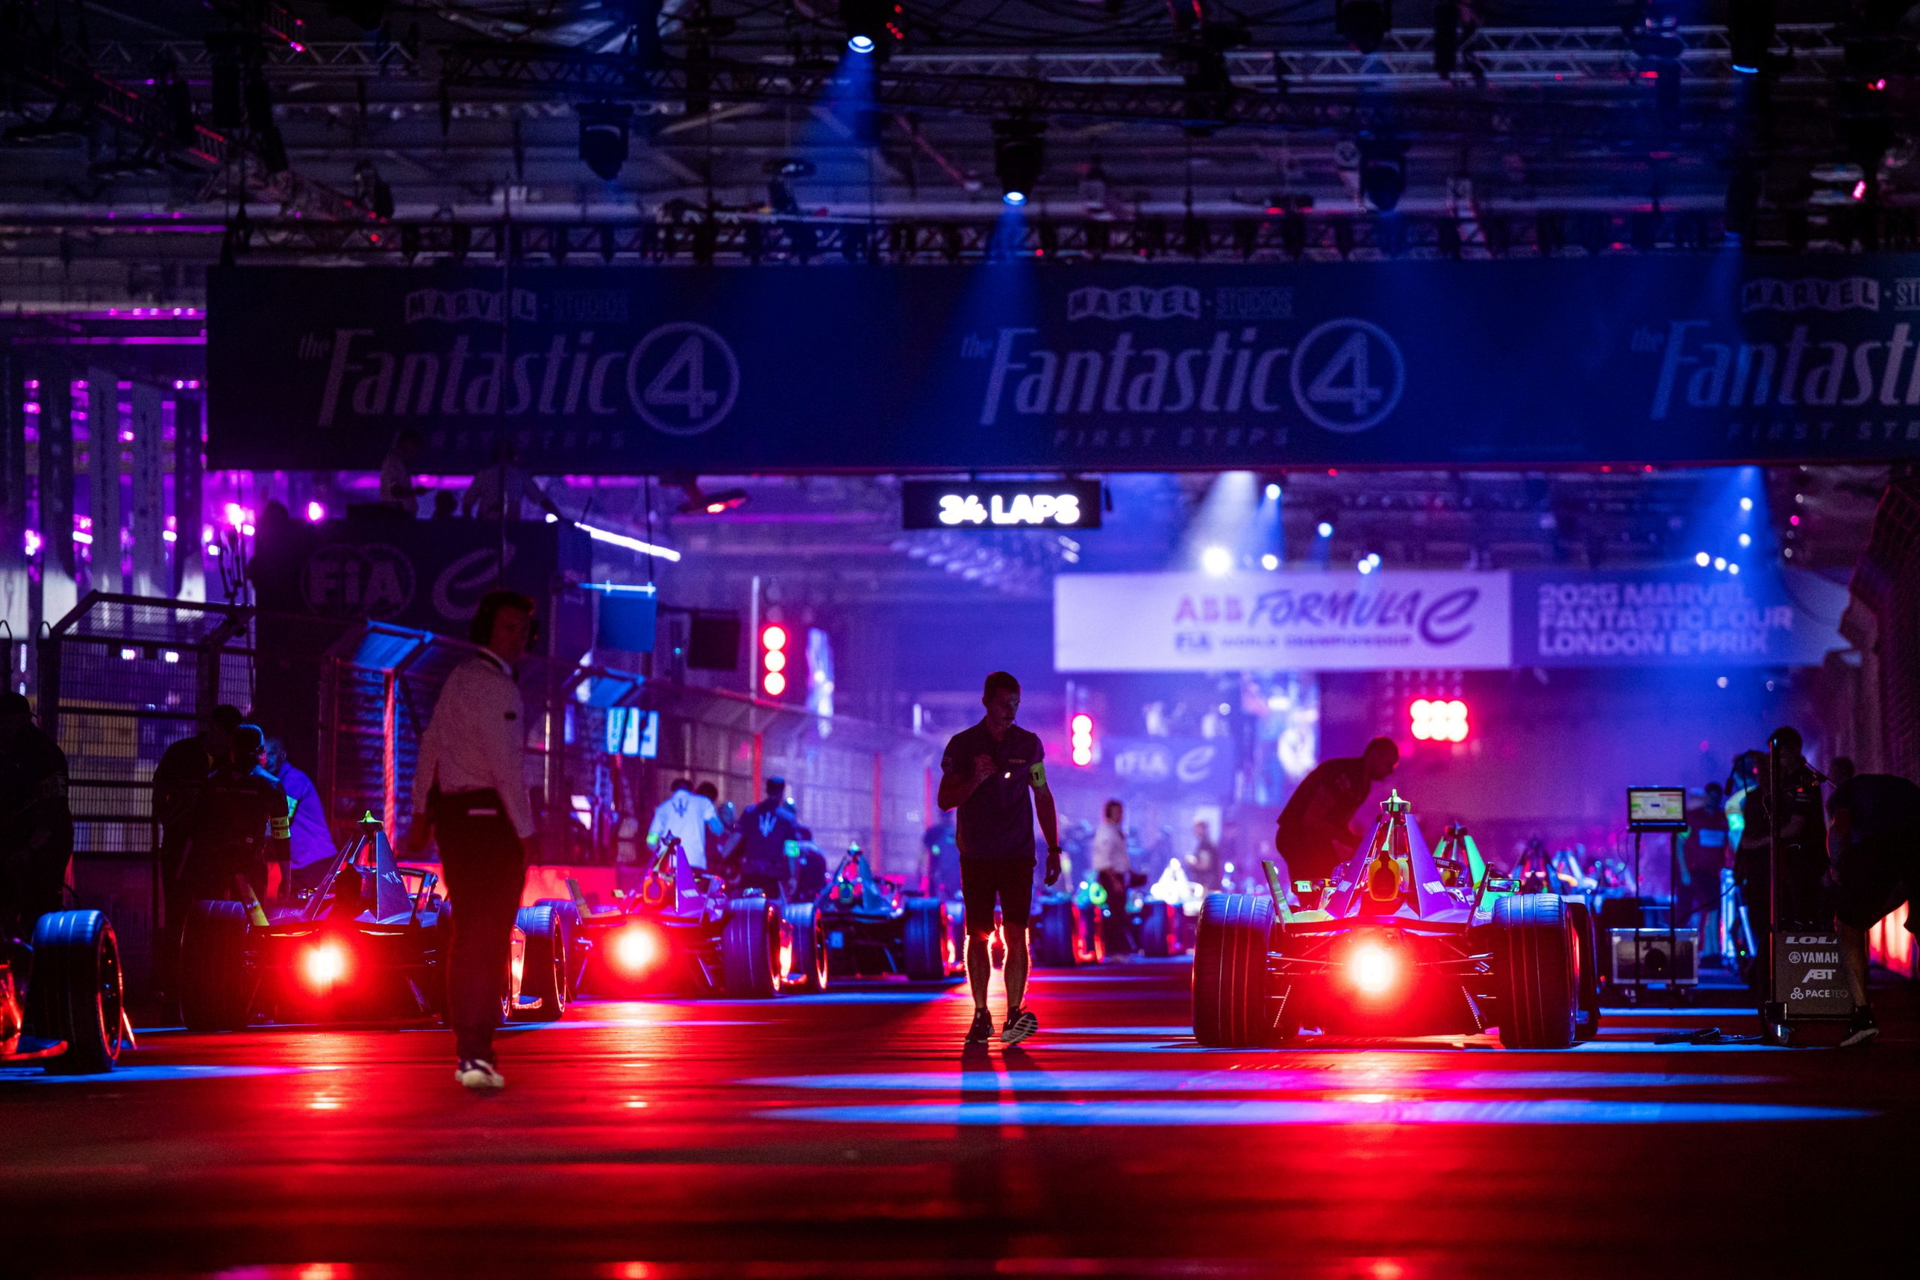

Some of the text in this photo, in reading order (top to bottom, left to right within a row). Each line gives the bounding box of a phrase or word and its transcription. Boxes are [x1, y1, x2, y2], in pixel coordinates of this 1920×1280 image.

[1067, 287, 1294, 320] MARVEL STUDIOS
[1742, 277, 1879, 312] MARVEL
[1630, 325, 1664, 351] the
[298, 332, 330, 359] the
[318, 328, 627, 427] Fantastic
[960, 332, 993, 358] the
[980, 327, 1290, 425] Fantastic
[1053, 428, 1290, 447] FIRST STEPS
[1727, 421, 1836, 441] FIRST
[939, 494, 1081, 525] 34 LAPS
[308, 561, 401, 604] FIA
[1538, 583, 1745, 605] 2025 MARVEL
[1175, 596, 1244, 622] ABB
[1247, 590, 1421, 627] FORMULA
[1538, 605, 1793, 630] FANTASTIC FOUR
[1175, 632, 1211, 651] FIA
[1538, 630, 1769, 656] LONDON E-PRIX
[1802, 968, 1836, 983] ABT
[1805, 989, 1849, 998] PACETEQ
